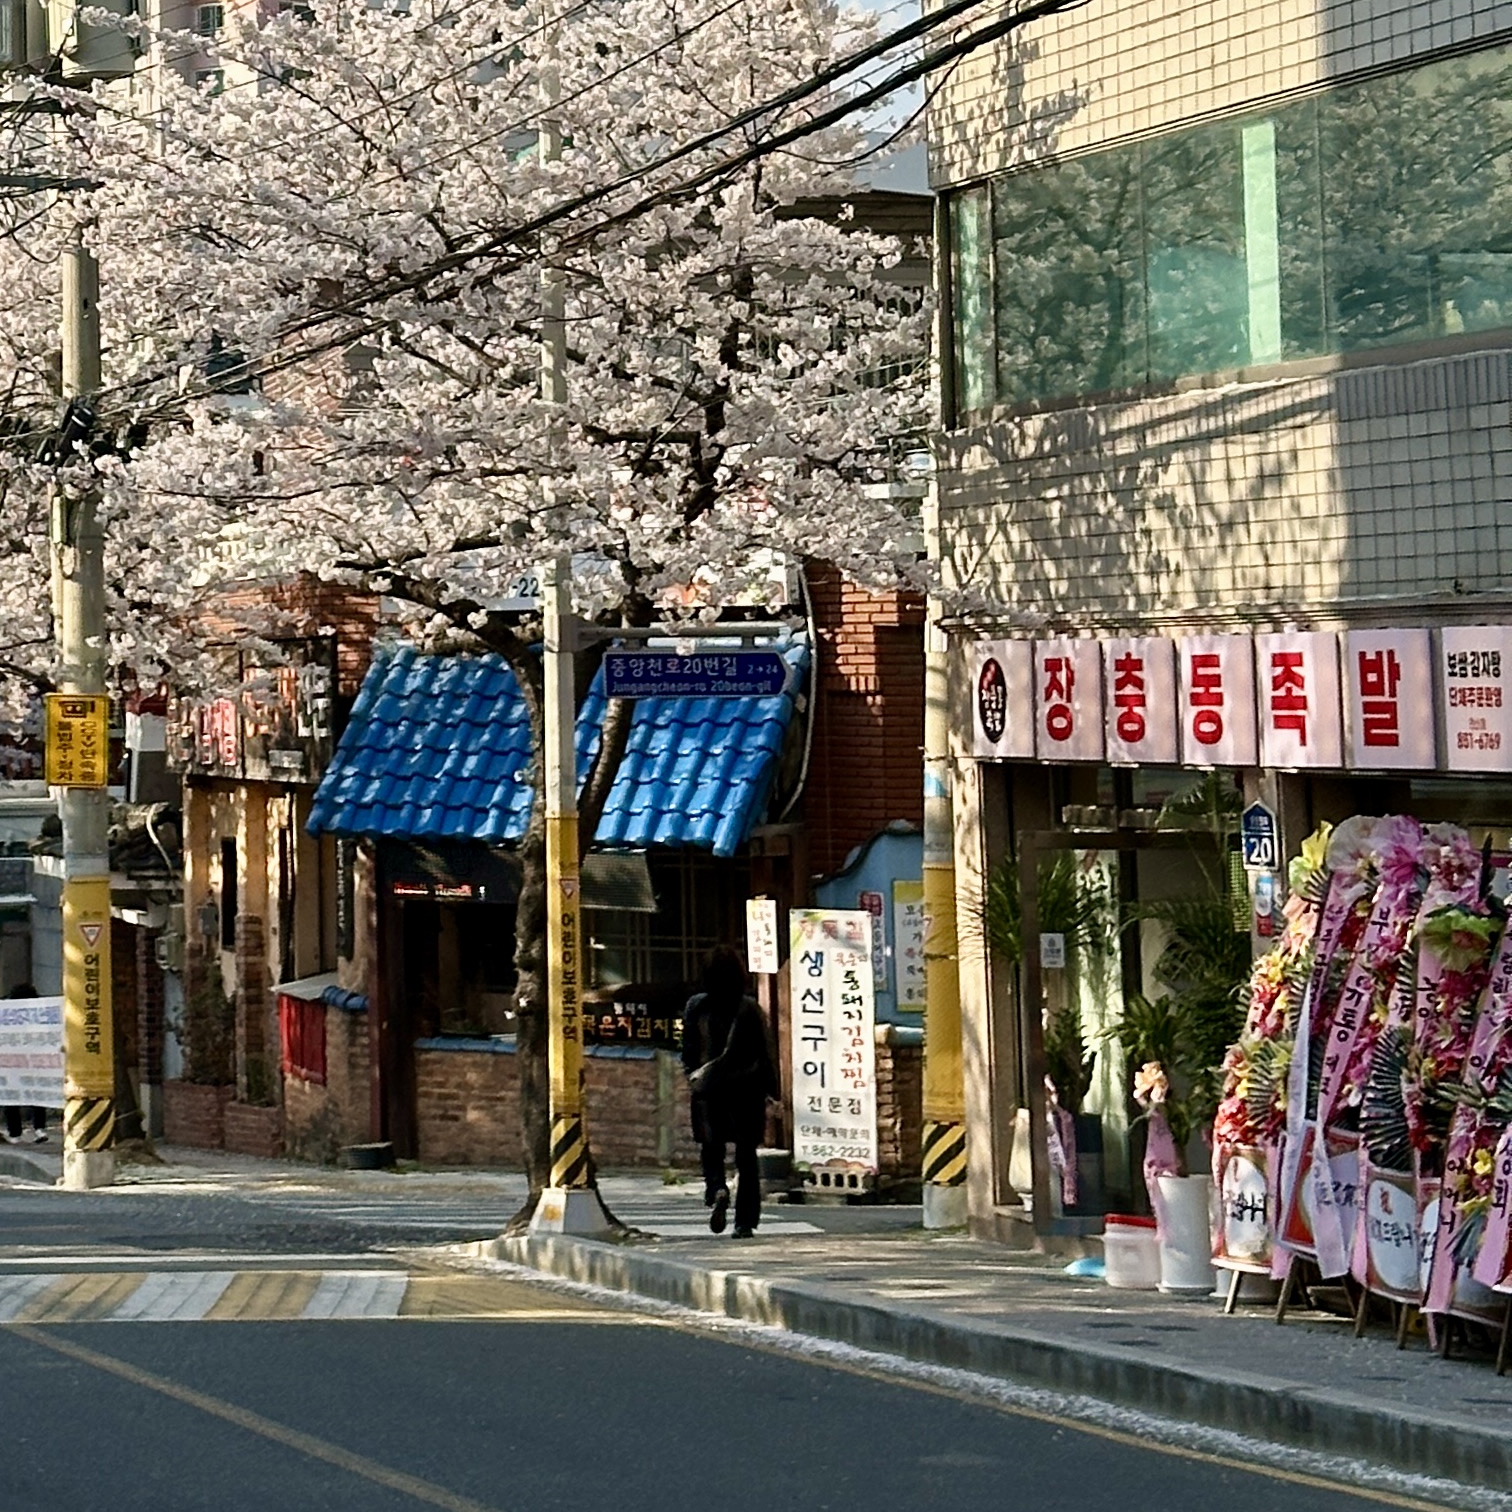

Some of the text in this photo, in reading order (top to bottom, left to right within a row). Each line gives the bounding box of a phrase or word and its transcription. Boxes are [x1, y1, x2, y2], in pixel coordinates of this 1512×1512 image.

[611, 657, 738, 679] 중앙천로20번길
[1043, 647, 1401, 747] 장충동족발
[1249, 837, 1273, 864] 20
[799, 950, 828, 1089] 생선구이
[807, 1095, 863, 1116] 전문점
